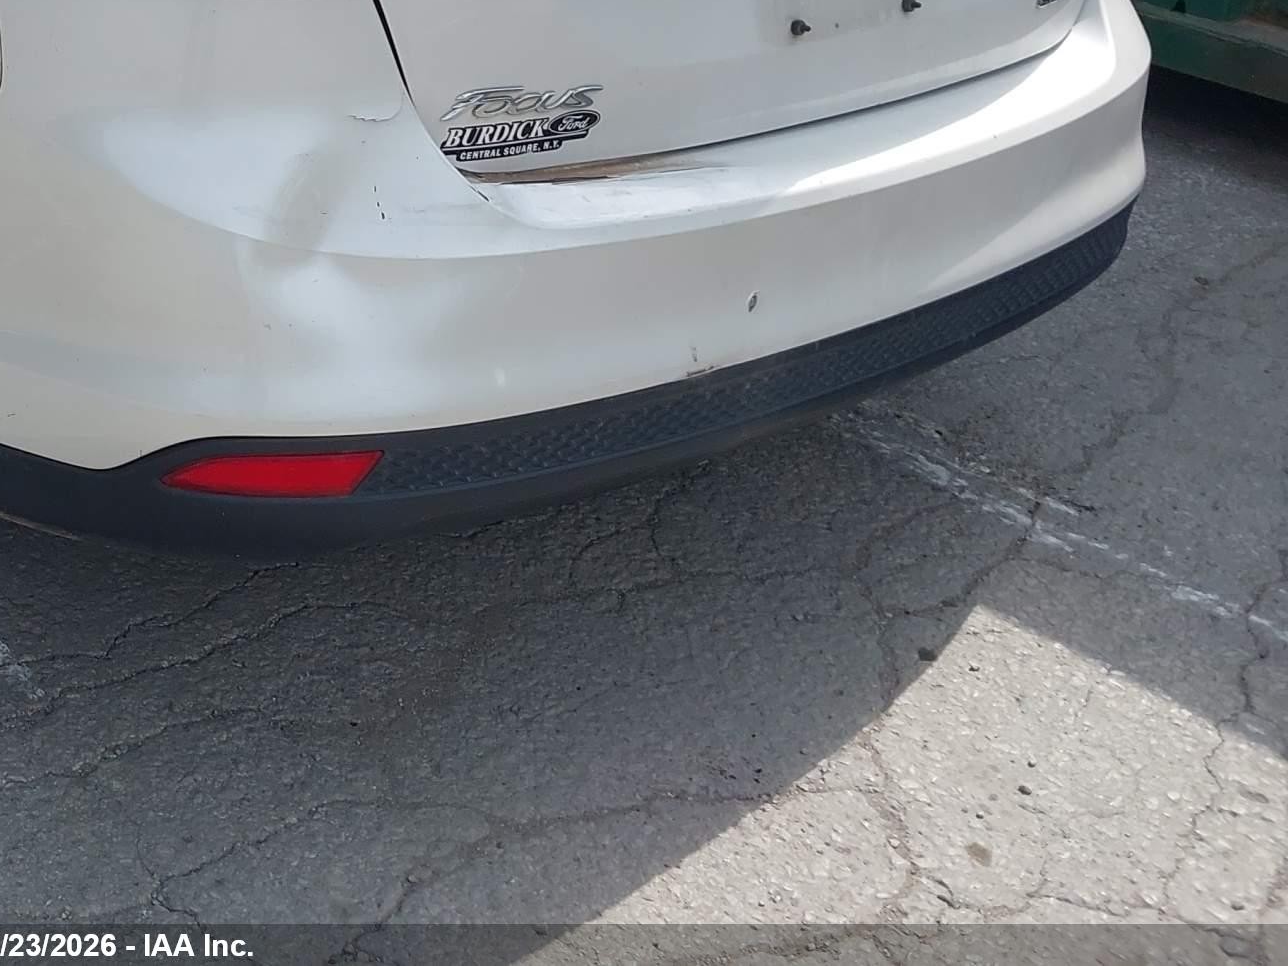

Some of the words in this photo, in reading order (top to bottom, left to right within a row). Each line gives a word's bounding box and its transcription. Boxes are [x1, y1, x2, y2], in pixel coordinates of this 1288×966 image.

[440, 84, 604, 122] Focus
[443, 118, 550, 149] BURDICK
[557, 114, 590, 132] Ford
[460, 148, 502, 161] CENTRAL
[503, 143, 542, 156] SQUARE,
